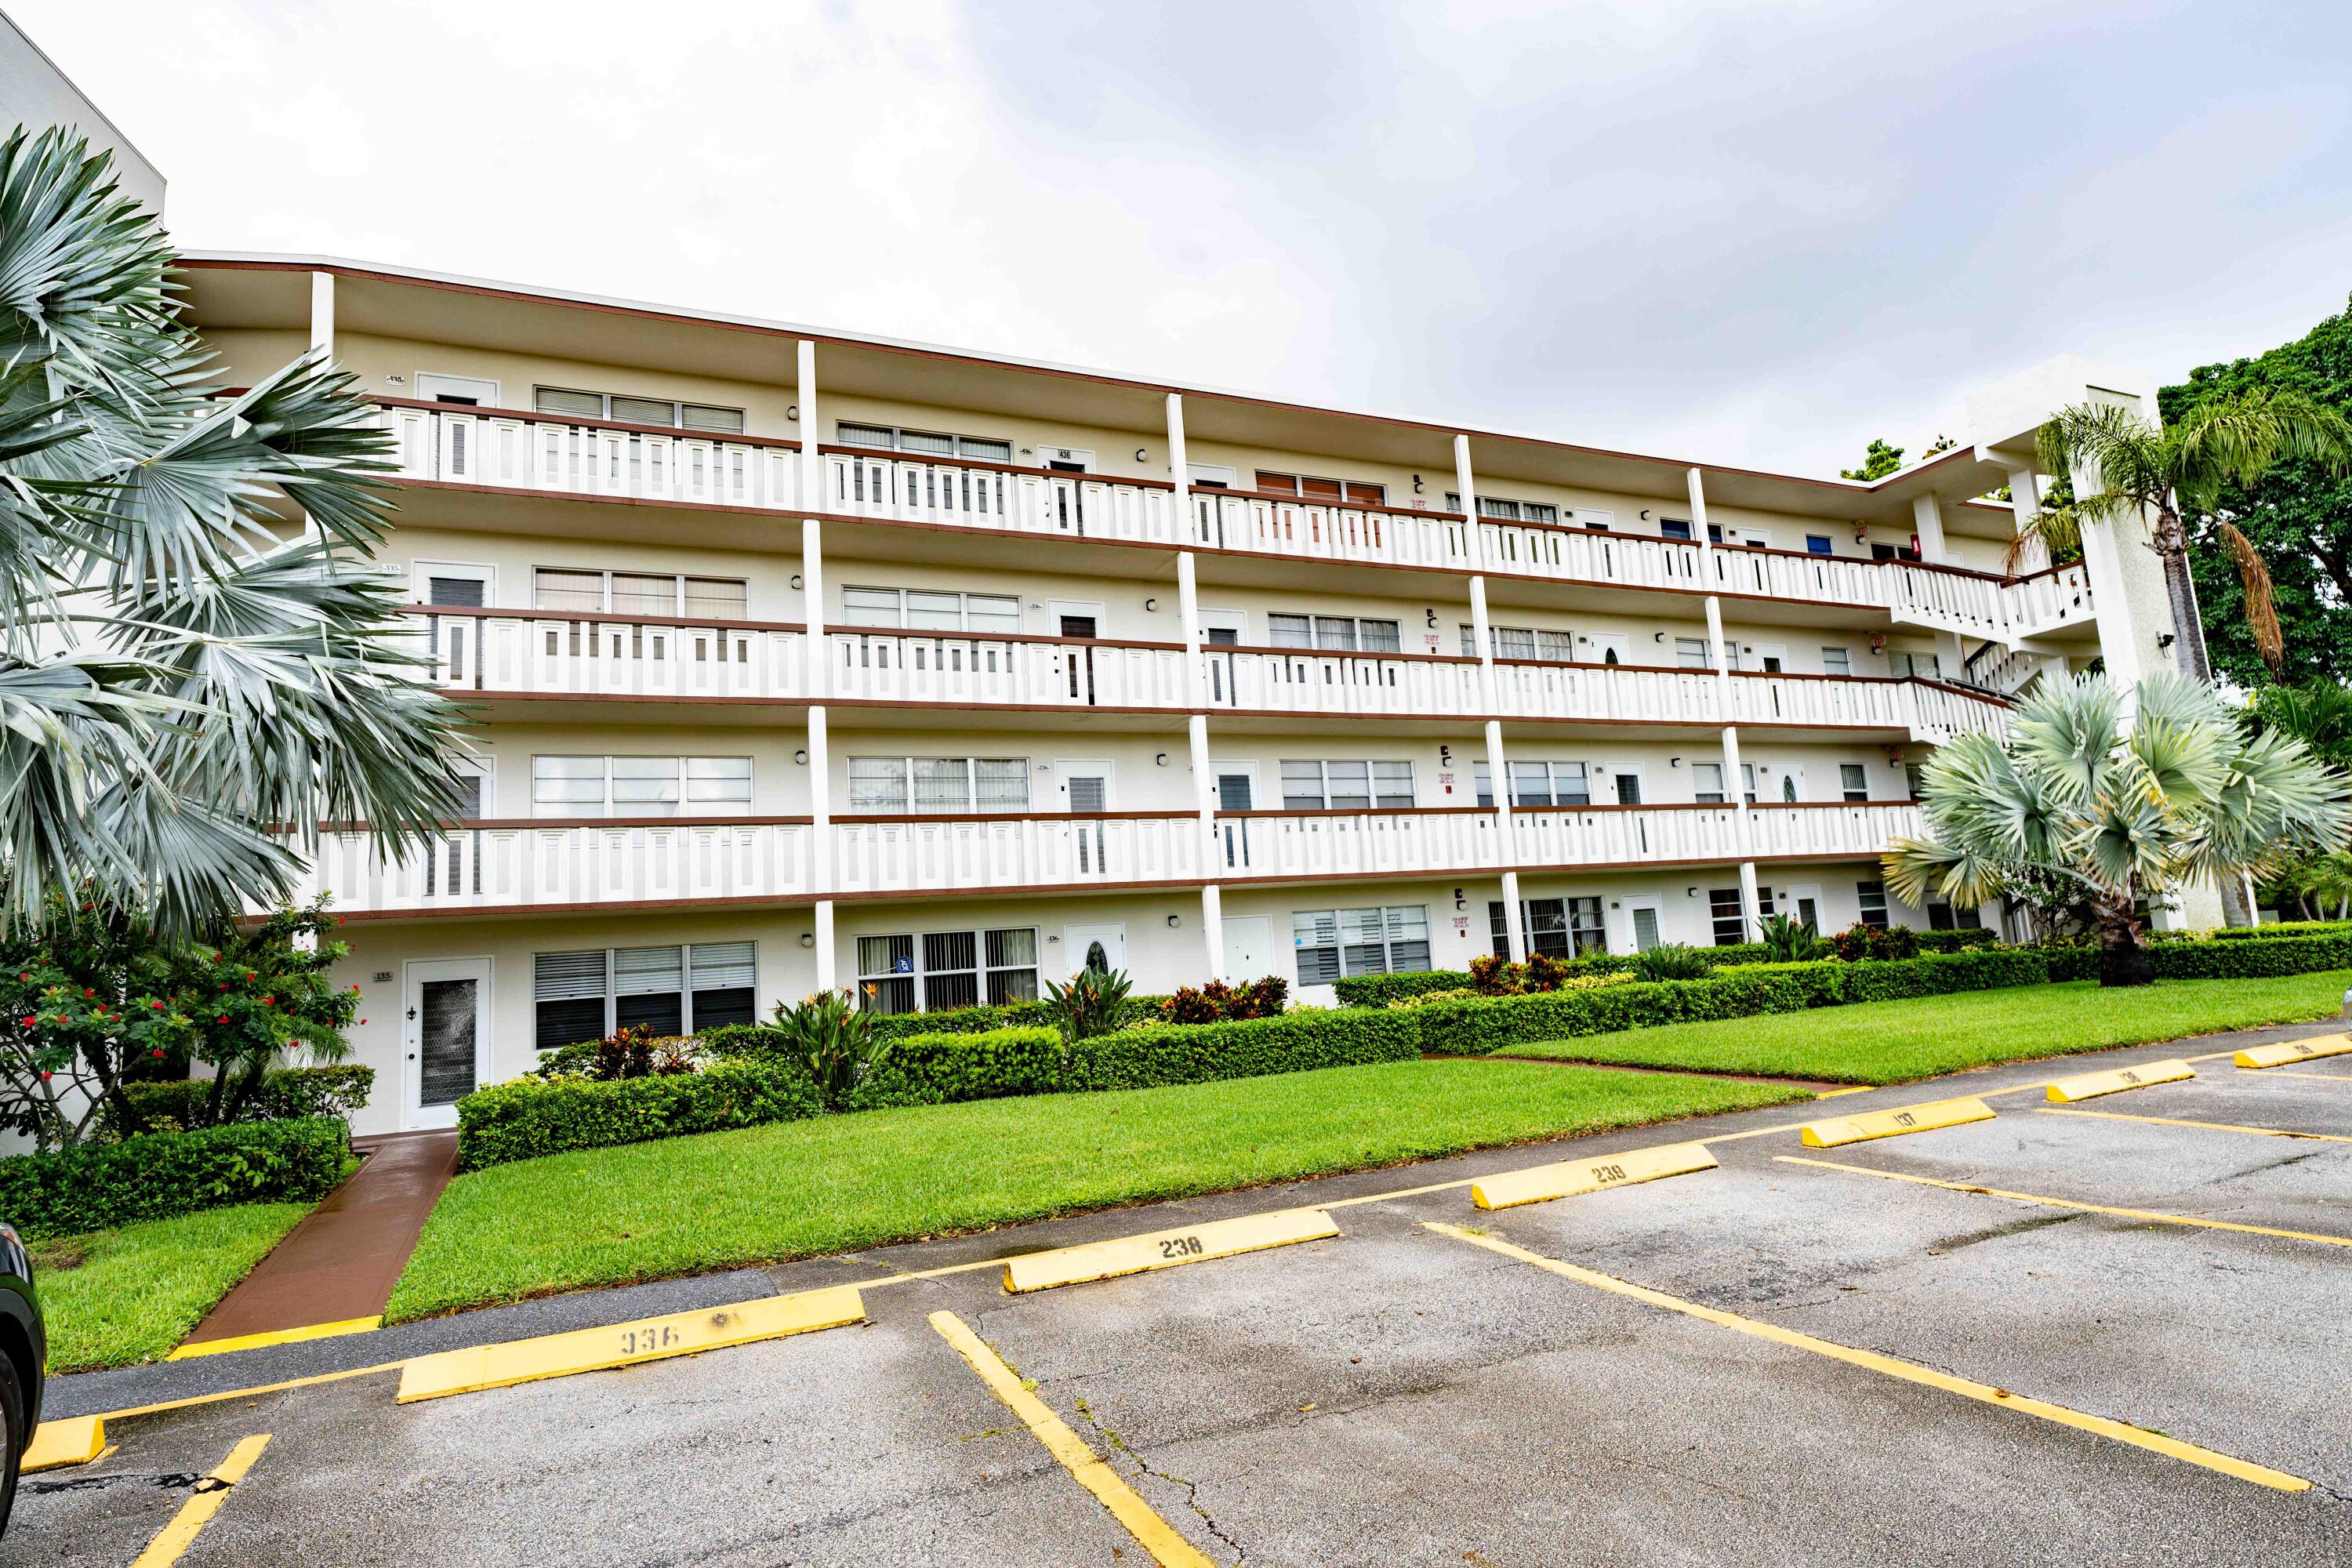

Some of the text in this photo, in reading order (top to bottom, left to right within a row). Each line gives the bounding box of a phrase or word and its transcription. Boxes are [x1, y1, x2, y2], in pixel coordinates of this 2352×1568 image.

[1060, 450, 1070, 459] 436
[1893, 1112, 1917, 1127] 137
[1159, 1236, 1203, 1258] 238
